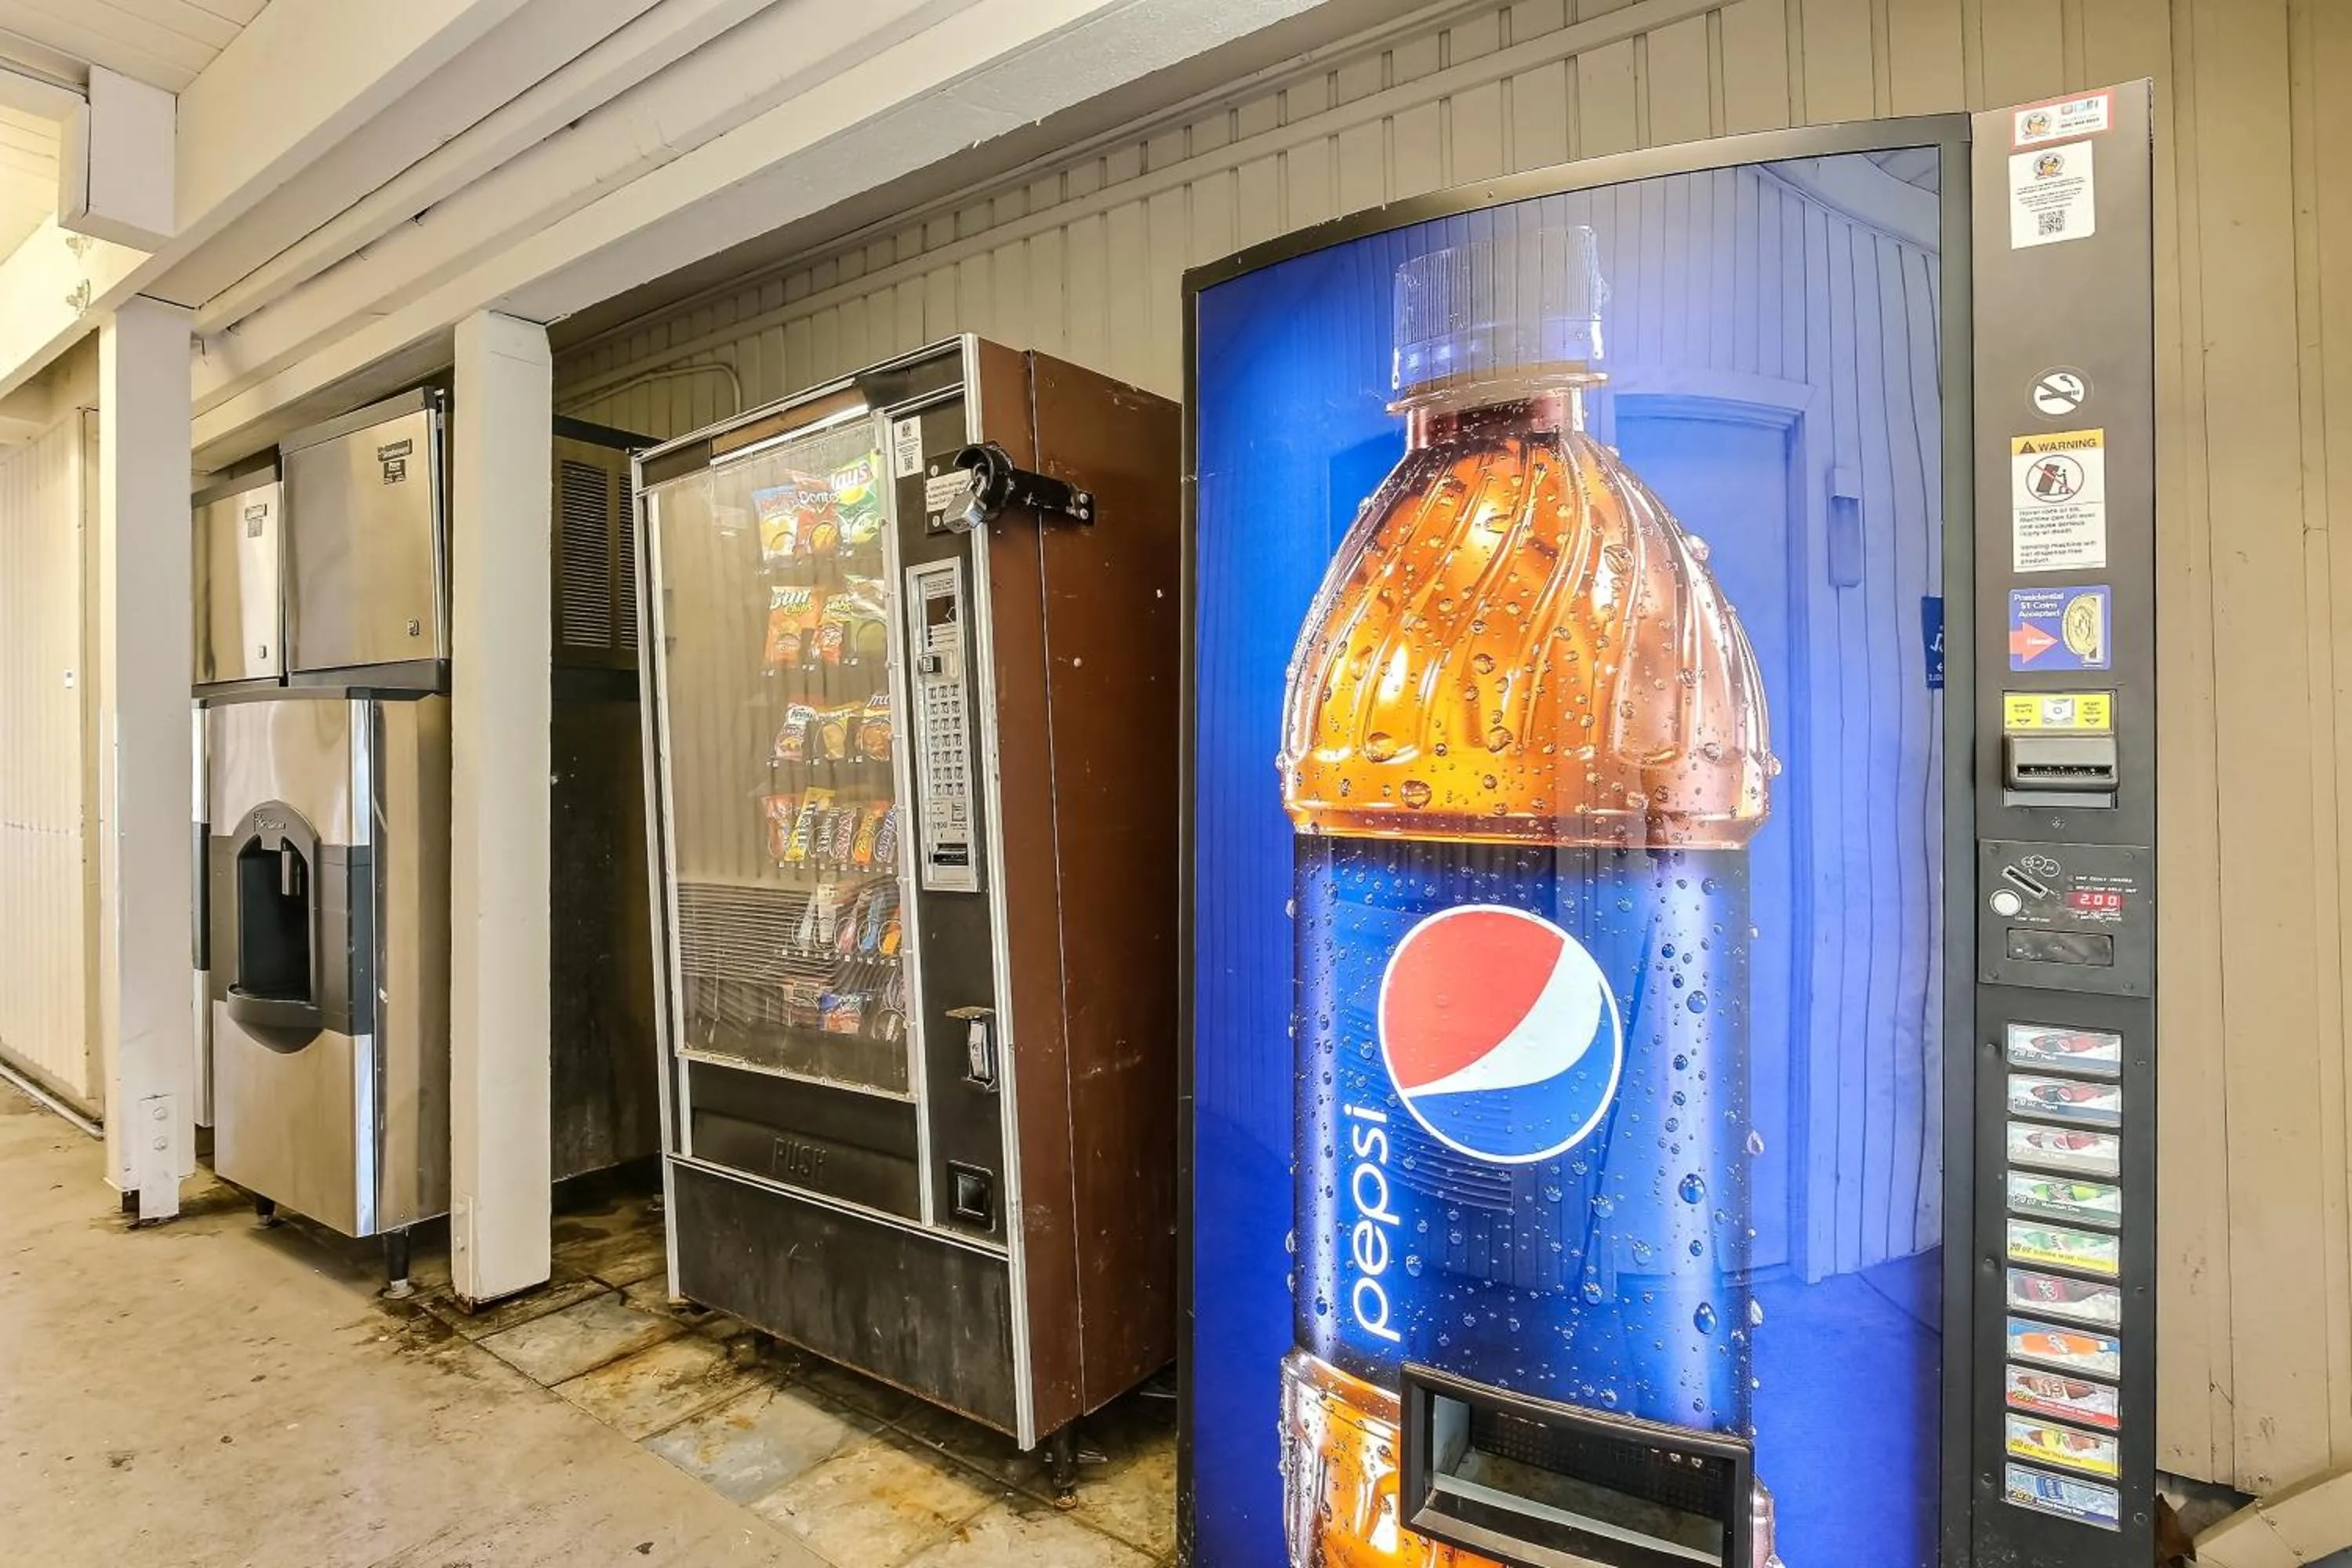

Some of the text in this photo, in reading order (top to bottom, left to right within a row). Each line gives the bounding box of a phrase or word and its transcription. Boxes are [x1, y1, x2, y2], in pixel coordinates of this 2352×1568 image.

[2038, 438, 2096, 452] WARNING
[2013, 592, 2064, 601] Presidential
[1342, 1103, 1402, 1343] pepsi
